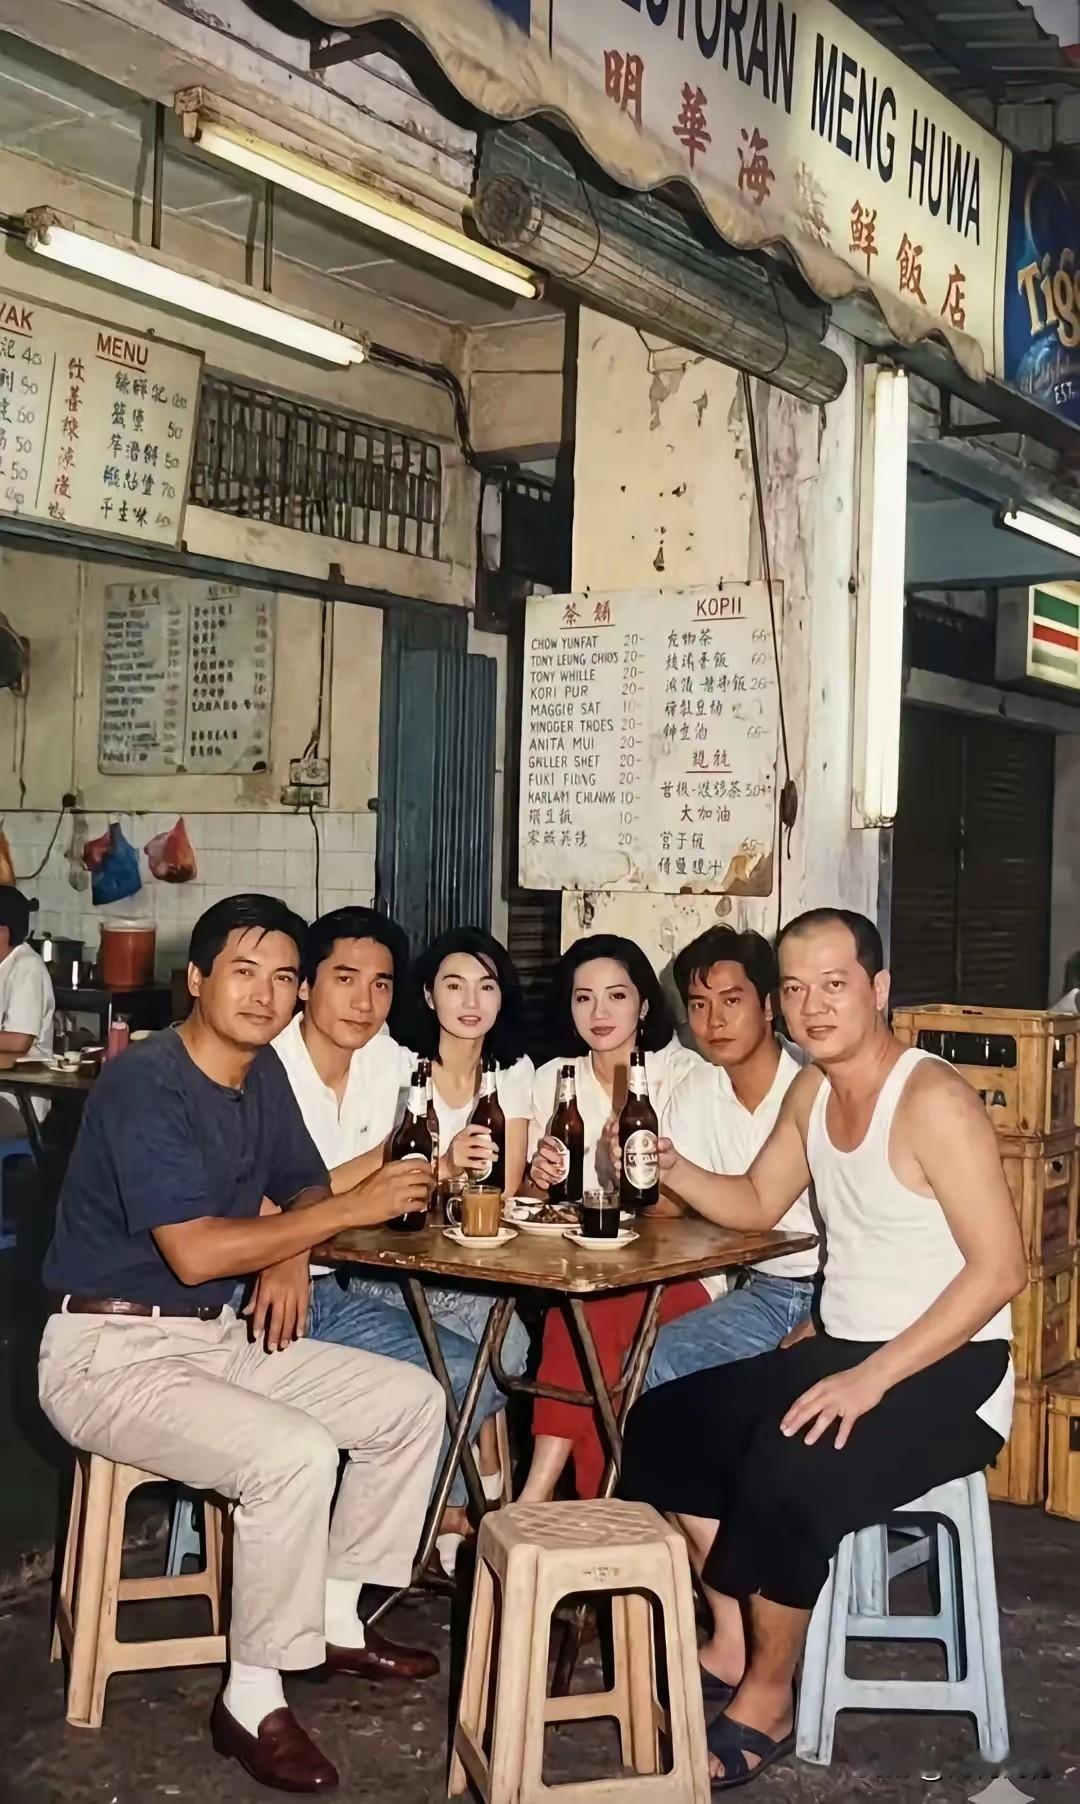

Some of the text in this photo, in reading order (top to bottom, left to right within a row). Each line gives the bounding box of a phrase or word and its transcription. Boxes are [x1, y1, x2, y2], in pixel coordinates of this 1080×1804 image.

[810, 33, 897, 183] MENG
[908, 109, 980, 245] HUWA
[96, 332, 149, 366] MENU
[697, 597, 741, 616] KOPII
[532, 638, 557, 650] CHOW
[562, 635, 599, 649] YUNFAT
[531, 655, 554, 666] TONY
[557, 653, 586, 666] LEUNG
[531, 671, 555, 683] TONY
[531, 687, 556, 700] KORI
[565, 685, 588, 698] PUR
[581, 702, 601, 715] SAT
[529, 738, 565, 751] ANITA
[573, 738, 594, 750] MUI
